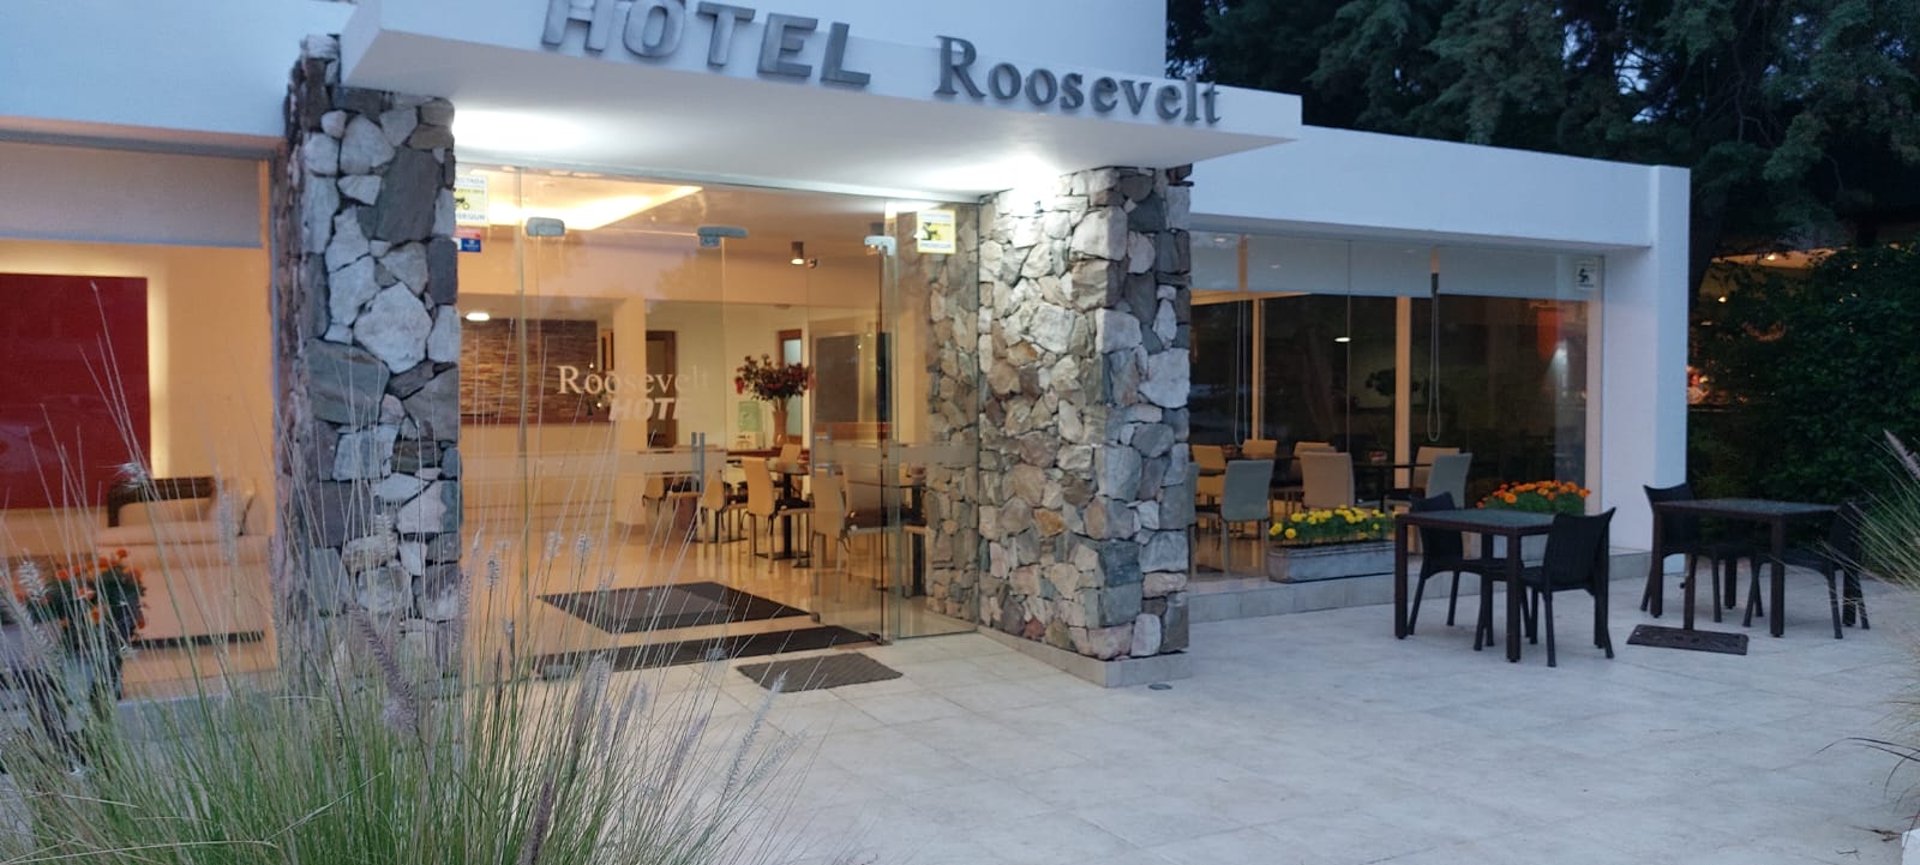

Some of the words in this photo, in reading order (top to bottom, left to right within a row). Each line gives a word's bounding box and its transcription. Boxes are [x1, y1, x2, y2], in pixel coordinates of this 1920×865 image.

[541, 0, 871, 87] HOTEL
[933, 35, 1222, 124] Roosevelt
[557, 364, 710, 395] Roosevelt
[608, 397, 698, 421] HOTE
